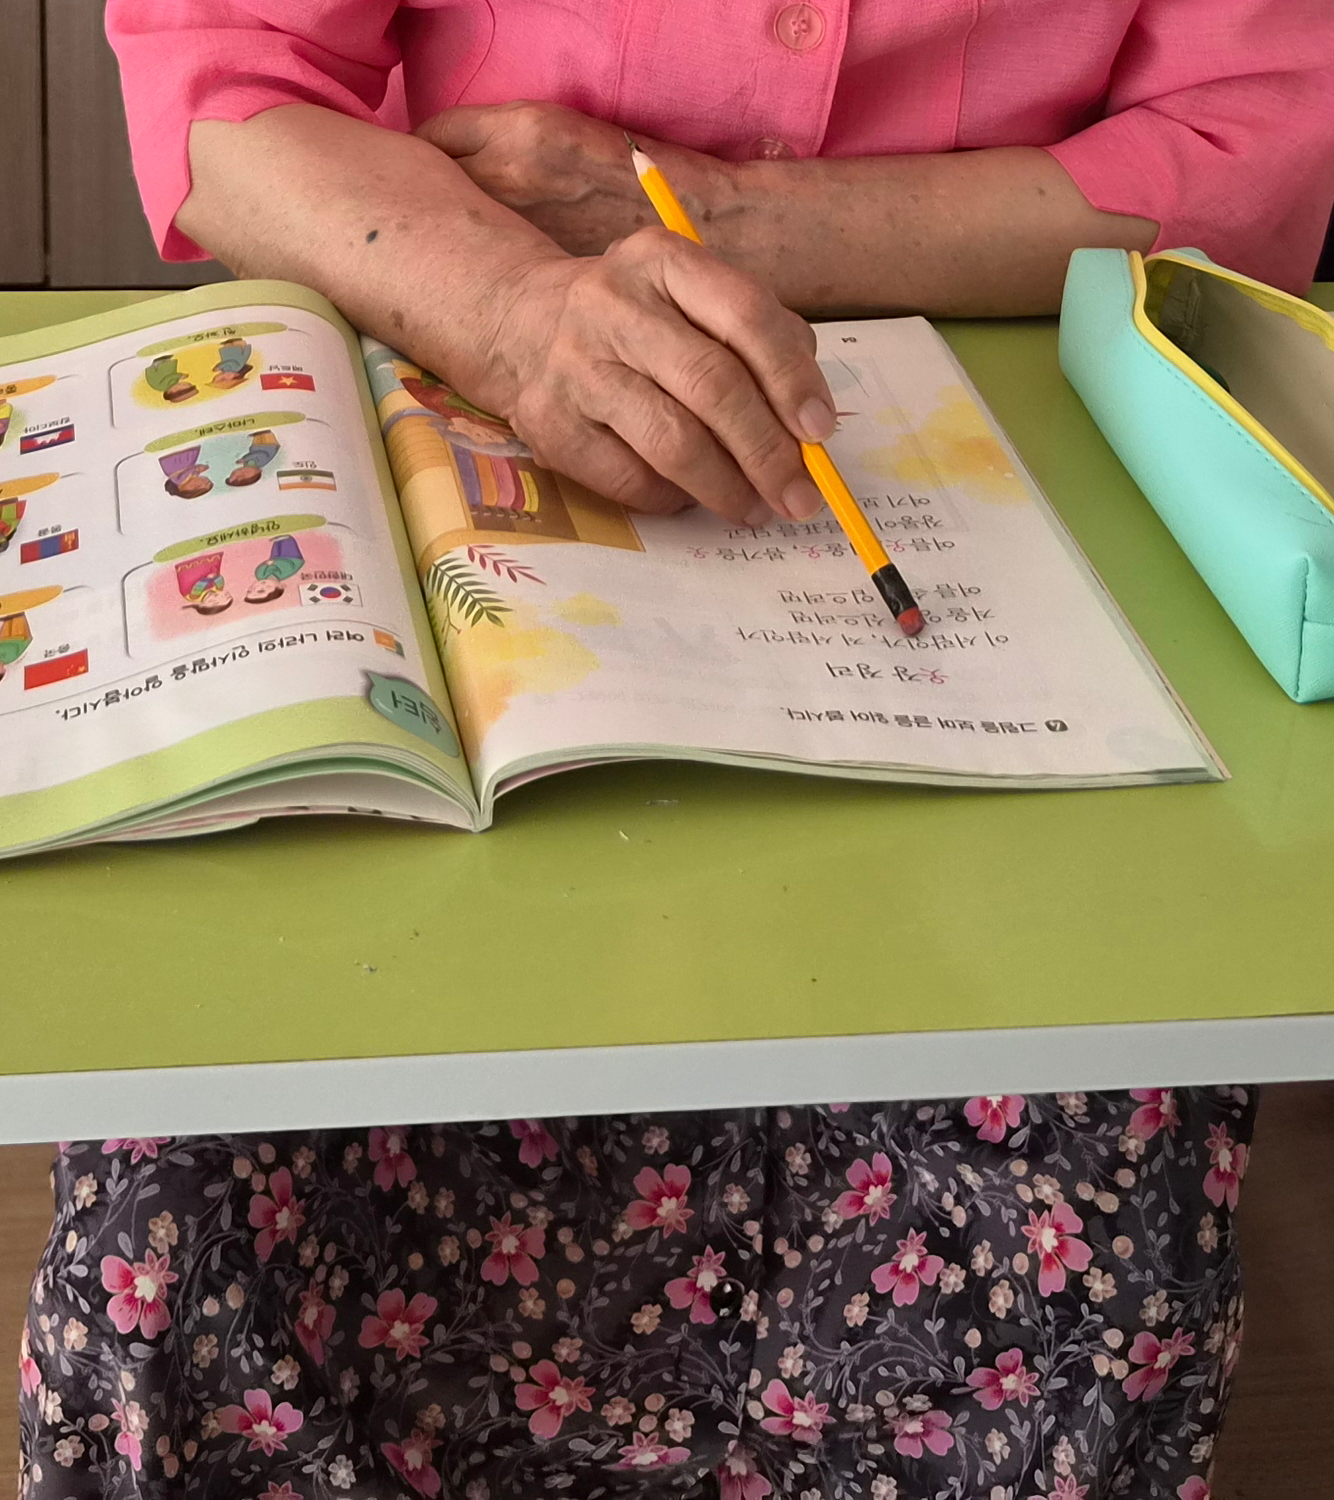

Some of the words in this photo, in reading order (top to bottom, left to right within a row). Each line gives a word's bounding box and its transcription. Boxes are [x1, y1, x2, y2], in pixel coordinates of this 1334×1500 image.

[268, 364, 303, 373] 베트남
[23, 417, 72, 435] 캄보디아
[194, 417, 256, 437] 나마스테.
[292, 460, 317, 469] 인도
[884, 493, 932, 509] 여기
[873, 514, 944, 532] 장롱이
[199, 520, 281, 546] 안녕하세요.
[686, 544, 710, 562] 옷
[715, 544, 788, 562] 봄가을
[791, 541, 860, 560] 울옷,
[299, 570, 354, 582] 대한민국
[776, 588, 875, 606] 입으려면
[933, 581, 982, 599] 여름
[787, 610, 887, 628] 신으려면
[946, 605, 996, 624] 겨울
[258, 632, 319, 653] 나라의
[326, 628, 365, 644] 여러
[735, 626, 833, 648] 서랍인가
[840, 633, 866, 647] 저
[984, 631, 1010, 648] 이
[44, 644, 71, 658] 중국
[170, 645, 251, 681] 인사말을
[824, 661, 885, 681] 정리
[892, 665, 948, 686] 옷장
[54, 674, 164, 721] 알아봅시다.
[779, 707, 846, 722] 봅시다.
[893, 714, 934, 729] 글을
[935, 717, 976, 731] 보며
[979, 720, 1038, 735] 그림을
